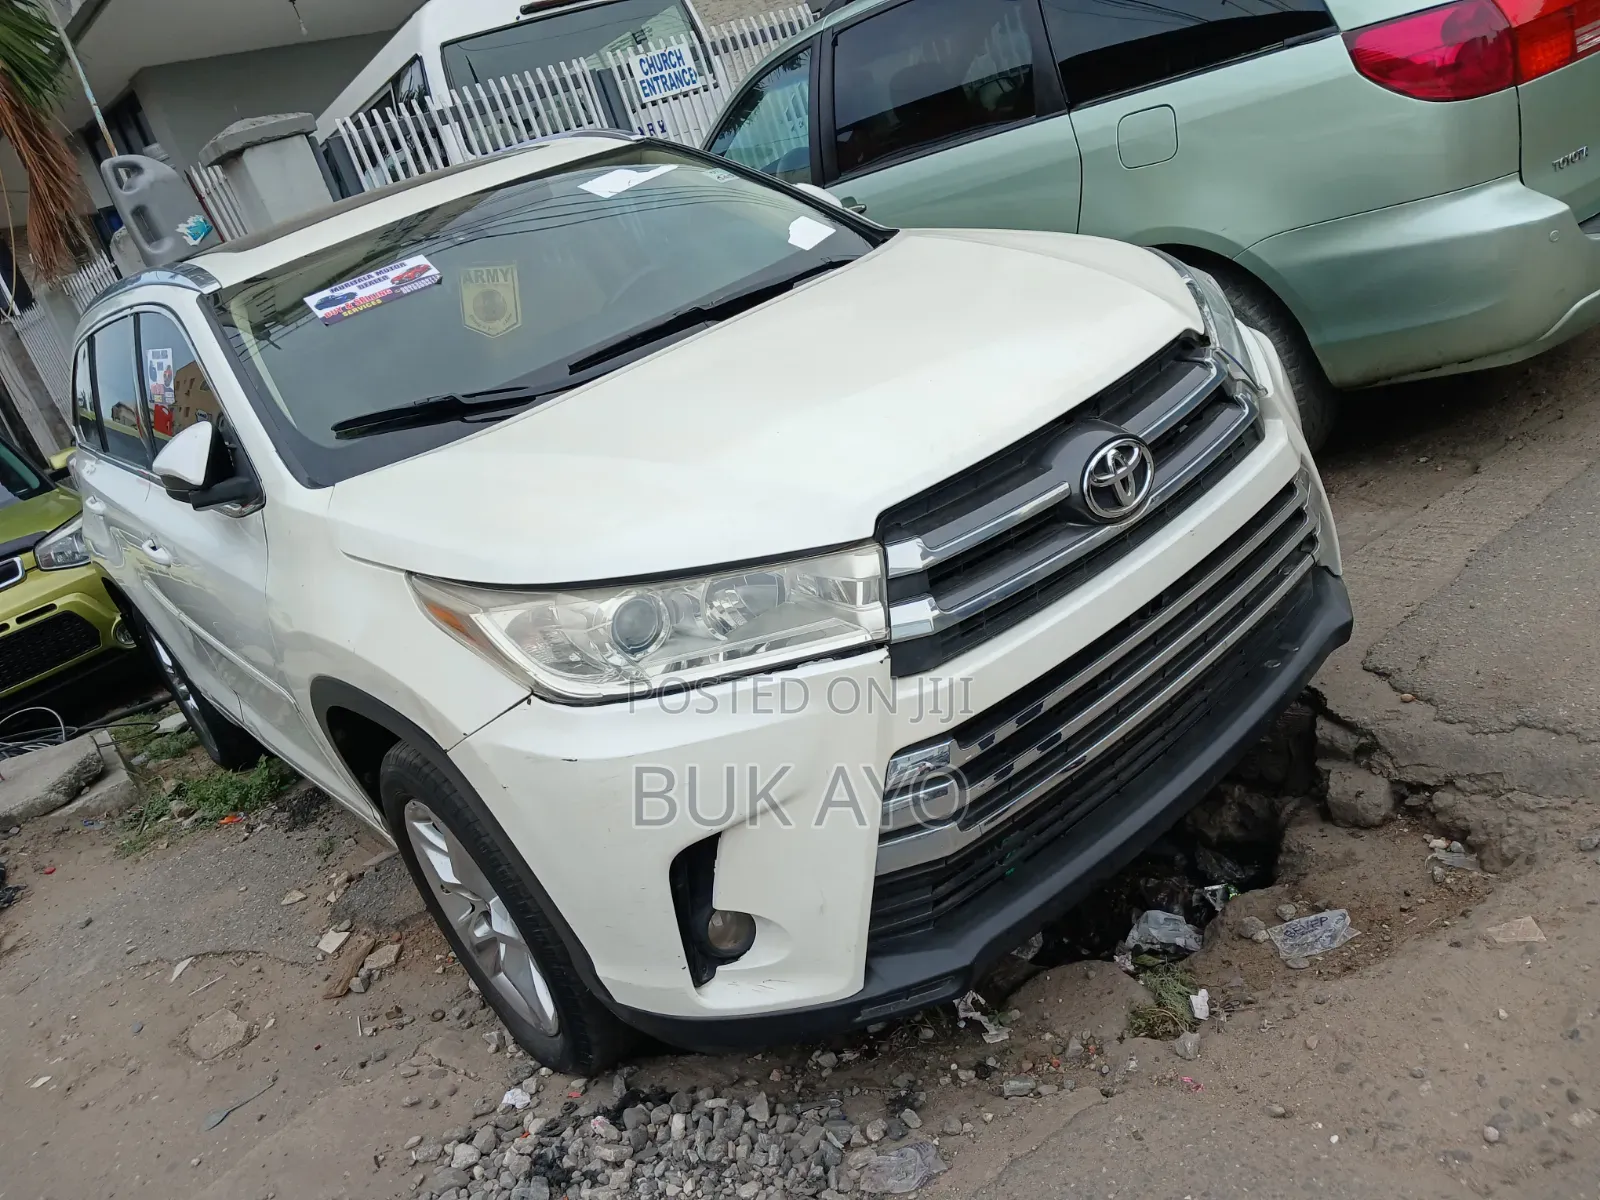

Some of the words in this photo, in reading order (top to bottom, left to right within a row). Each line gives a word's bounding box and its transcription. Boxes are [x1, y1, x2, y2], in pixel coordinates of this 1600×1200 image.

[639, 48, 686, 76] CHURCH
[639, 66, 698, 98] ENTRANCE
[375, 262, 407, 277] MOTOR
[462, 267, 511, 284] ARMY
[357, 275, 390, 290] DEALER
[324, 306, 343, 319] BUY
[345, 302, 354, 310] &
[342, 299, 382, 317] SERVICES
